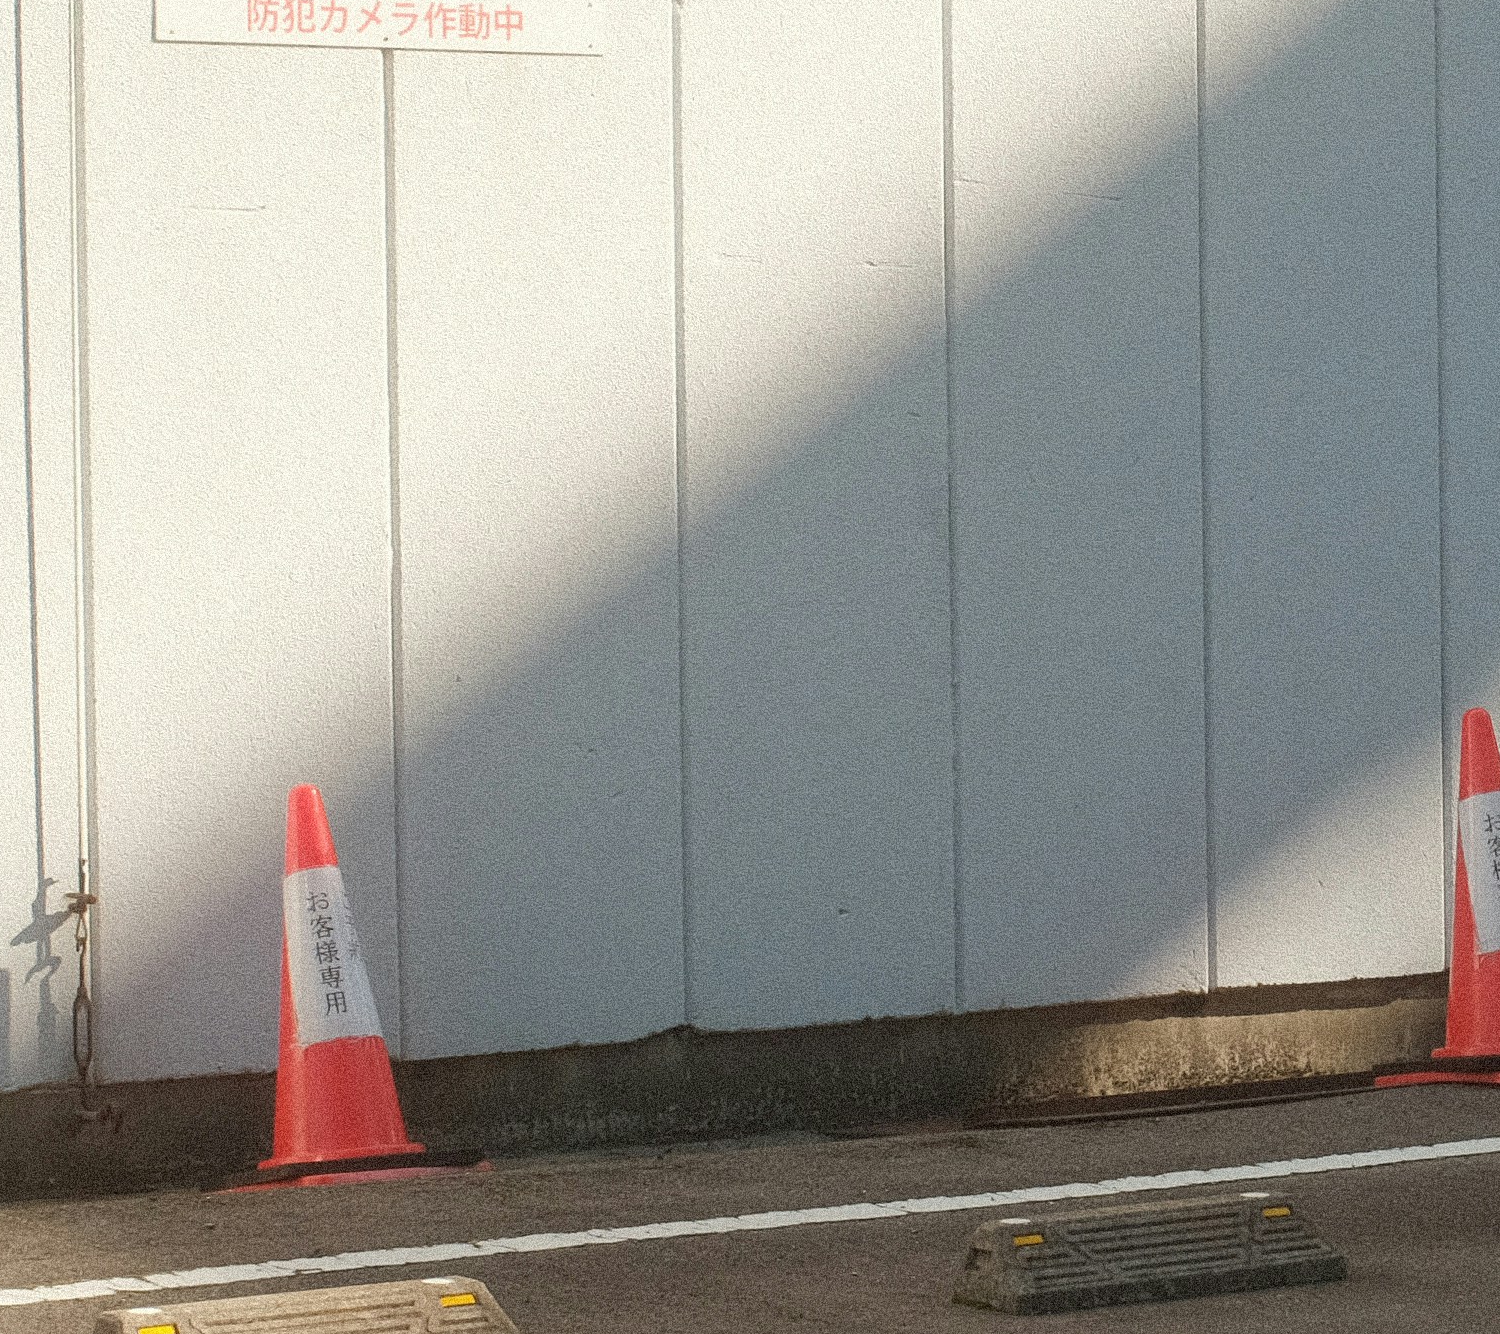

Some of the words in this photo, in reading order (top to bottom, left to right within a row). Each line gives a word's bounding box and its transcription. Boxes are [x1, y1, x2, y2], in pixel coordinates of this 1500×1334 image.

[306, 890, 348, 1017] お客様専用
